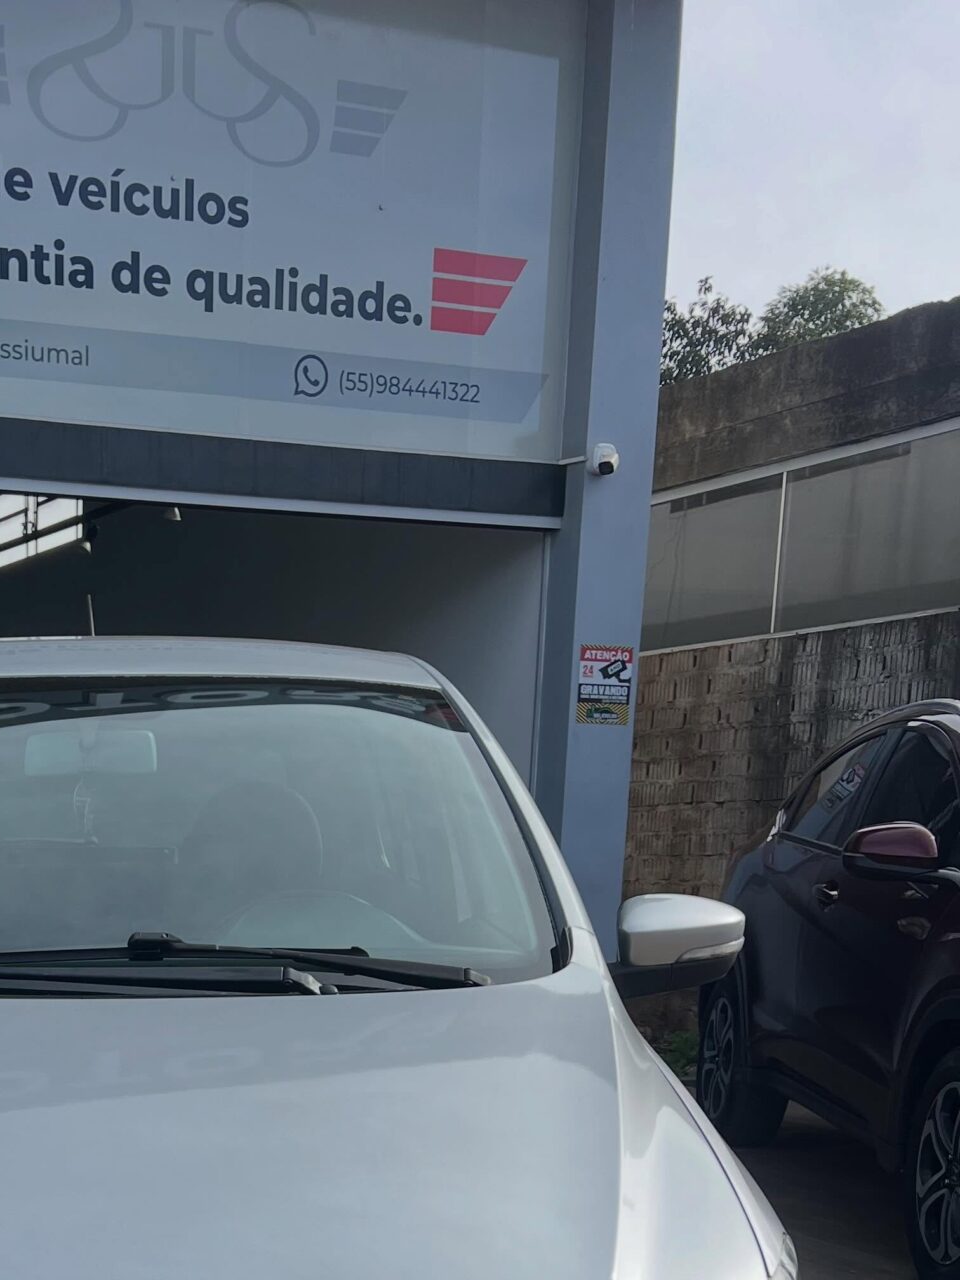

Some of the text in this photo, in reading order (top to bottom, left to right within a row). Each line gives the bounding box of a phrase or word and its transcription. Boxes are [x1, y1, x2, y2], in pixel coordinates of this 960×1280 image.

[47, 167, 250, 230] veículos
[111, 251, 172, 298] de
[186, 269, 425, 327] qualidade.
[340, 370, 481, 403] (55)984441322
[584, 649, 630, 661] ATENÇÃO
[581, 685, 628, 695] GRAVANDO
